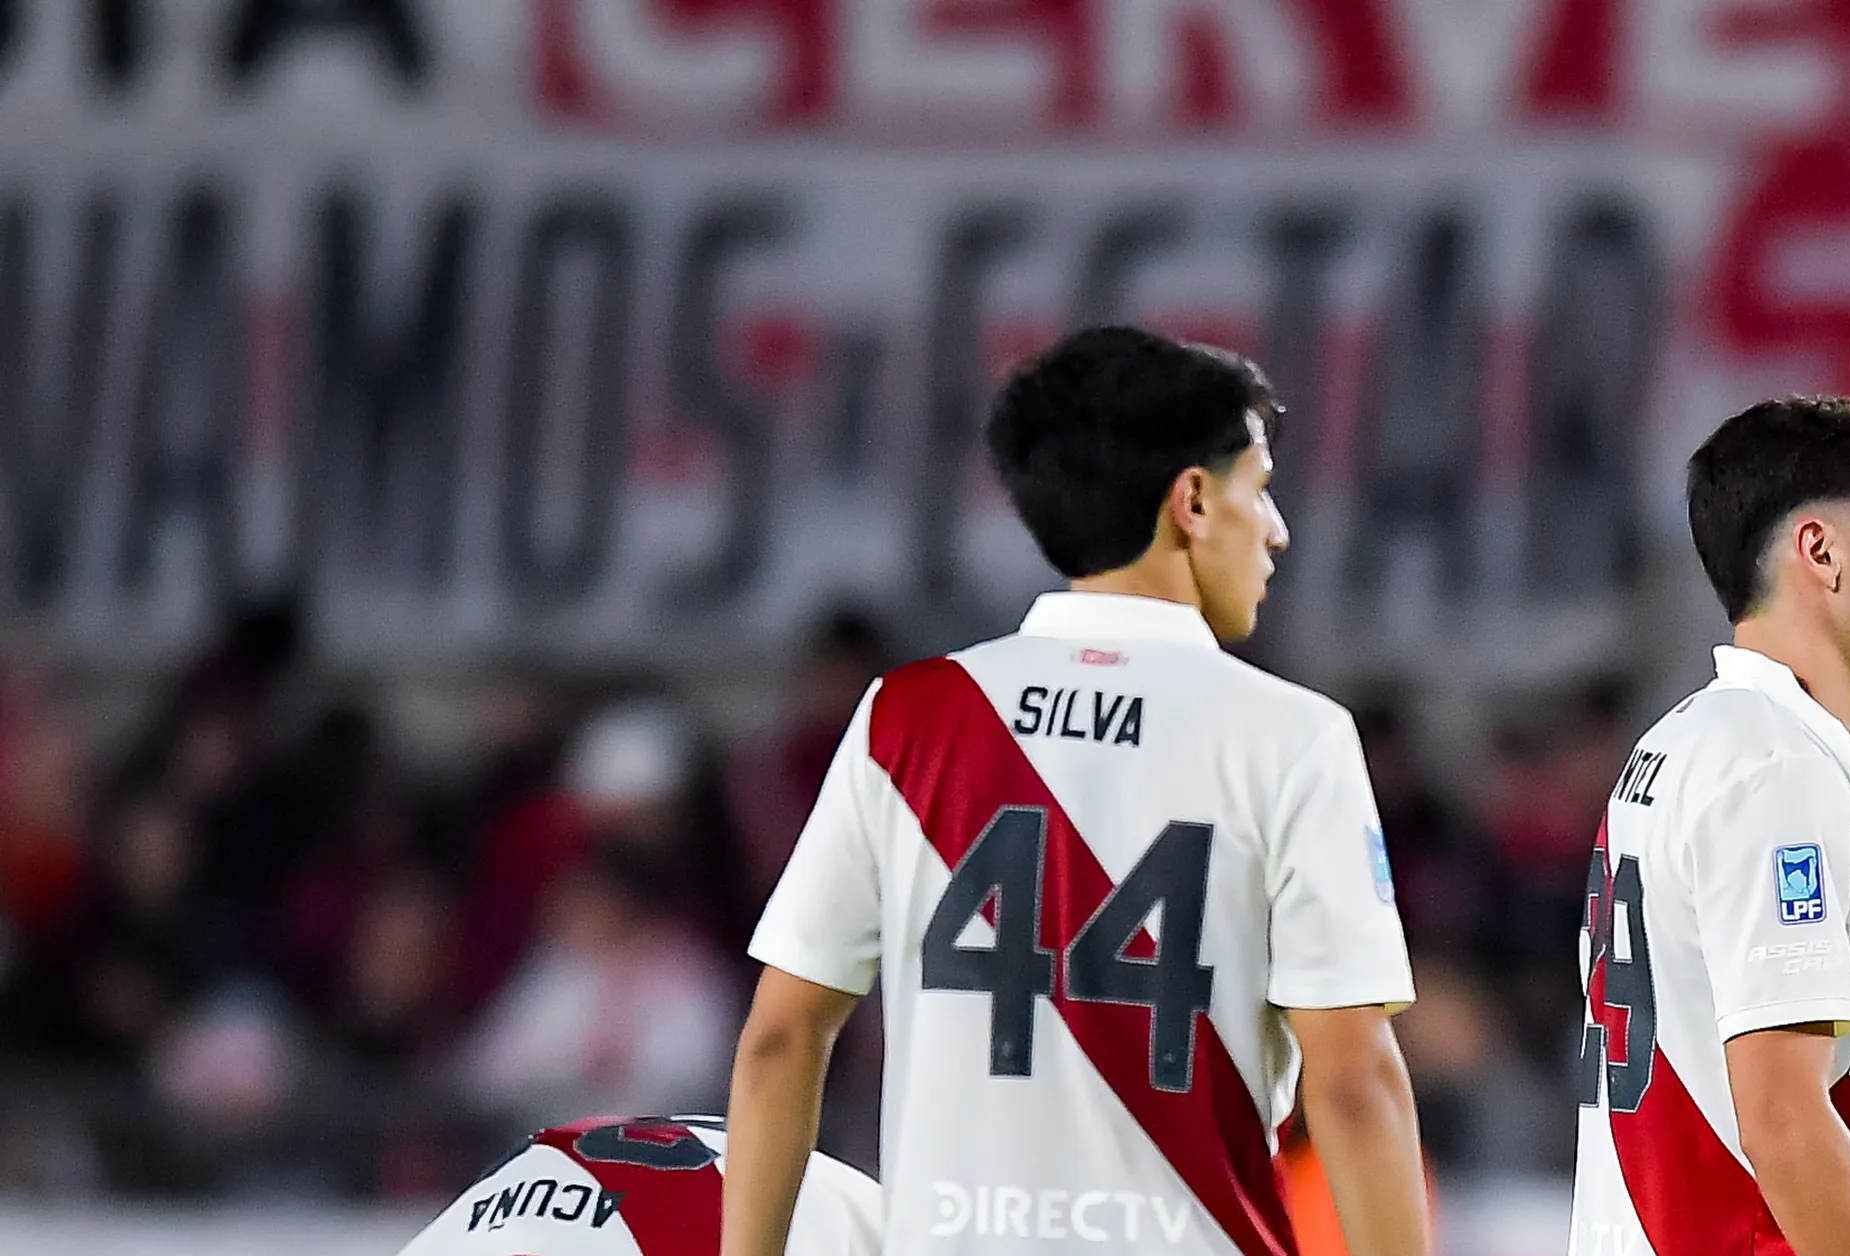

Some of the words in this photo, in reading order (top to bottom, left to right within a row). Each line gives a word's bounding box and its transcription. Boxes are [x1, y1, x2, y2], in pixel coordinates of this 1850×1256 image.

[1014, 685, 1144, 748] SILVA
[1782, 899, 1821, 920] LPF
[921, 804, 1214, 1093] 44
[467, 1179, 627, 1232] ACUÑA
[930, 1180, 1195, 1242] DIRECTV
